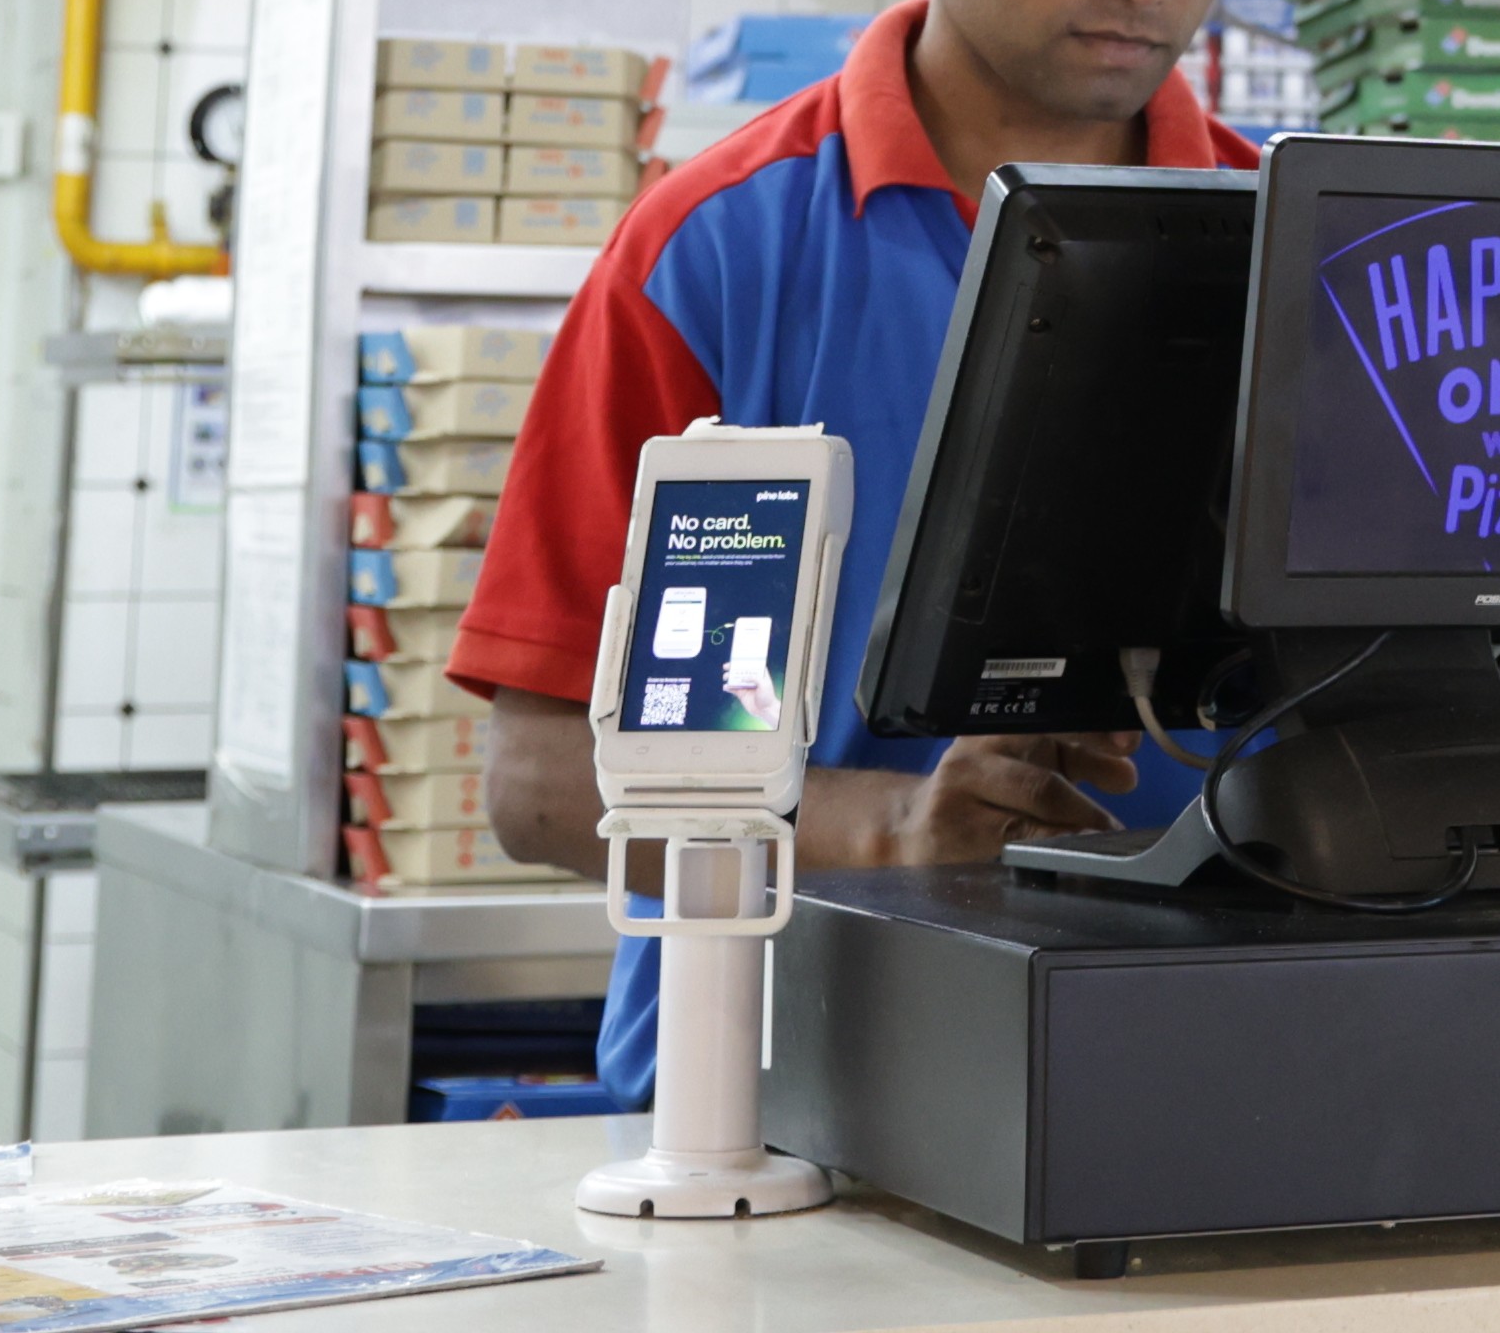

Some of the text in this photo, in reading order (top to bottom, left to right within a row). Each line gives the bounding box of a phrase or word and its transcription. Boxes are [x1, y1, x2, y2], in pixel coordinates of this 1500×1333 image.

[671, 514, 751, 531] No card.
[668, 532, 786, 553] No problem.
